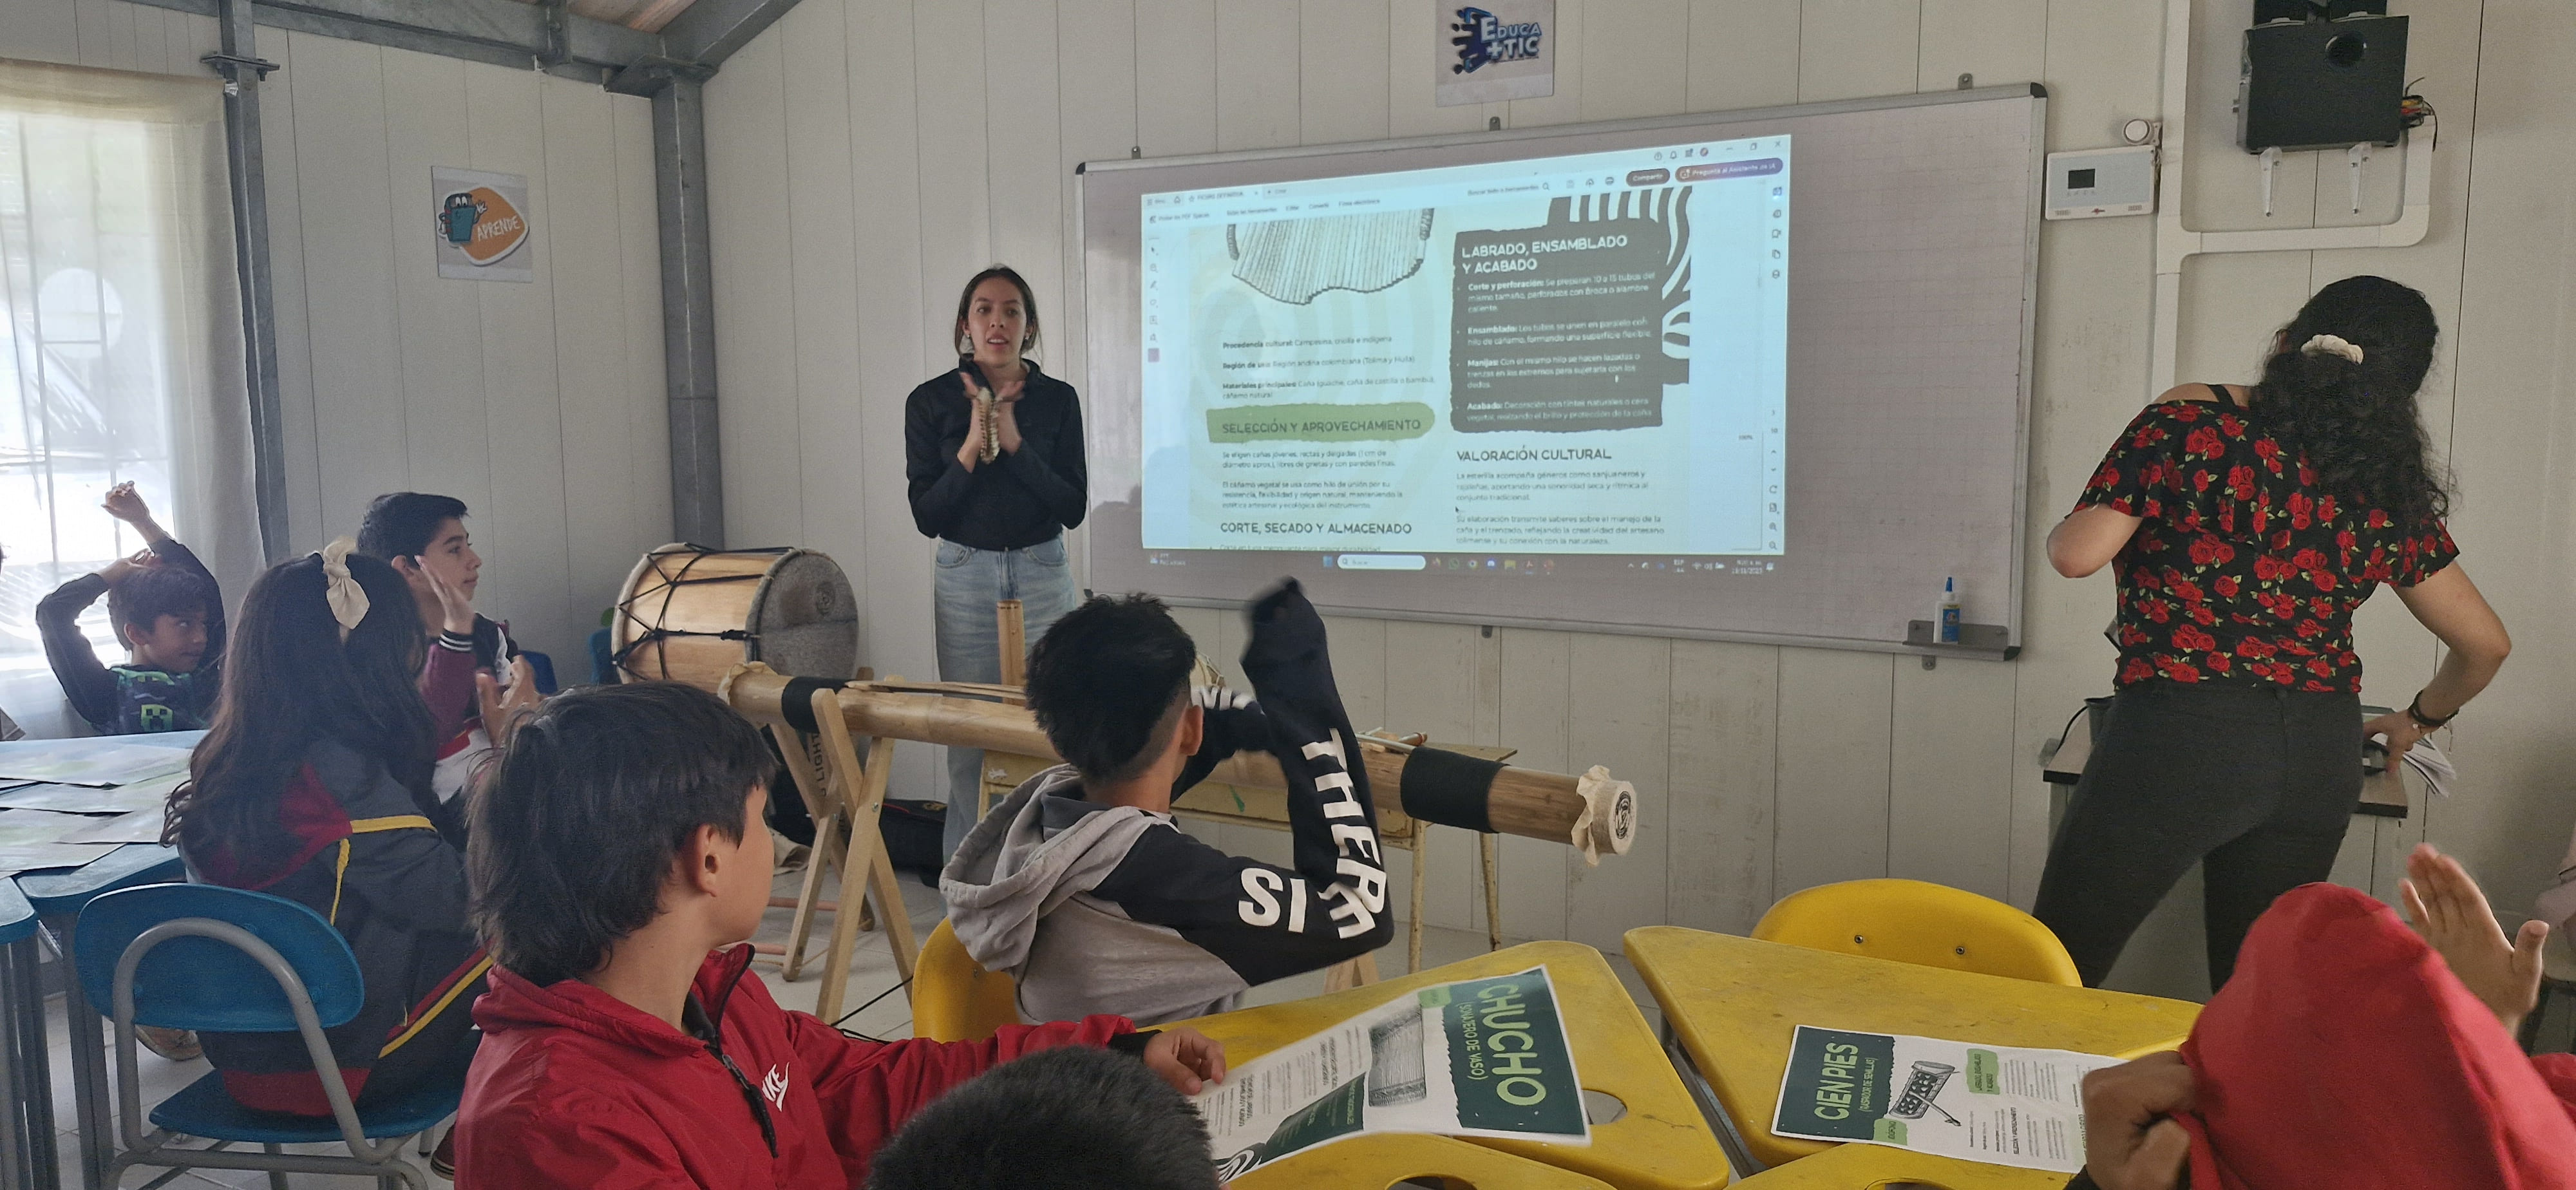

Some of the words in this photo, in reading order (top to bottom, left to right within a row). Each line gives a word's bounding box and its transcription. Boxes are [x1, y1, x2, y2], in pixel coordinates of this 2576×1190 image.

[1481, 17, 1542, 42] EDUCA
[477, 216, 520, 241] APRENDE
[1462, 243, 1529, 258] LABRADO,
[1531, 235, 1628, 253] ENSAMBLADO
[1462, 262, 1472, 274] Y
[1473, 258, 1539, 273] ACABADO
[1468, 283, 1490, 291] Corte
[1497, 280, 1544, 291] perforación:
[1468, 325, 1517, 334] Ensamblado:
[1467, 359, 1499, 368] Manijas:
[1222, 419, 1288, 433] SELECCIÓN
[1289, 422, 1299, 432] Y
[1300, 420, 1421, 432] APROVECHAMIENTO
[1456, 446, 1539, 461] VALORACIÓN
[1540, 448, 1612, 460] CULTURAL
[1220, 522, 1262, 536] CORTE,
[1264, 522, 1313, 533] SECADO
[1315, 523, 1325, 533] Y
[1327, 523, 1412, 534] ALMACENADO
[811, 733, 825, 782] LIGHT
[1465, 1041, 1481, 1052] DE
[1477, 984, 1547, 1106] CHUCHO
[1467, 1053, 1488, 1080] VASO)
[1822, 1042, 1859, 1079] PIES
[1814, 1079, 1855, 1120] CIEN
